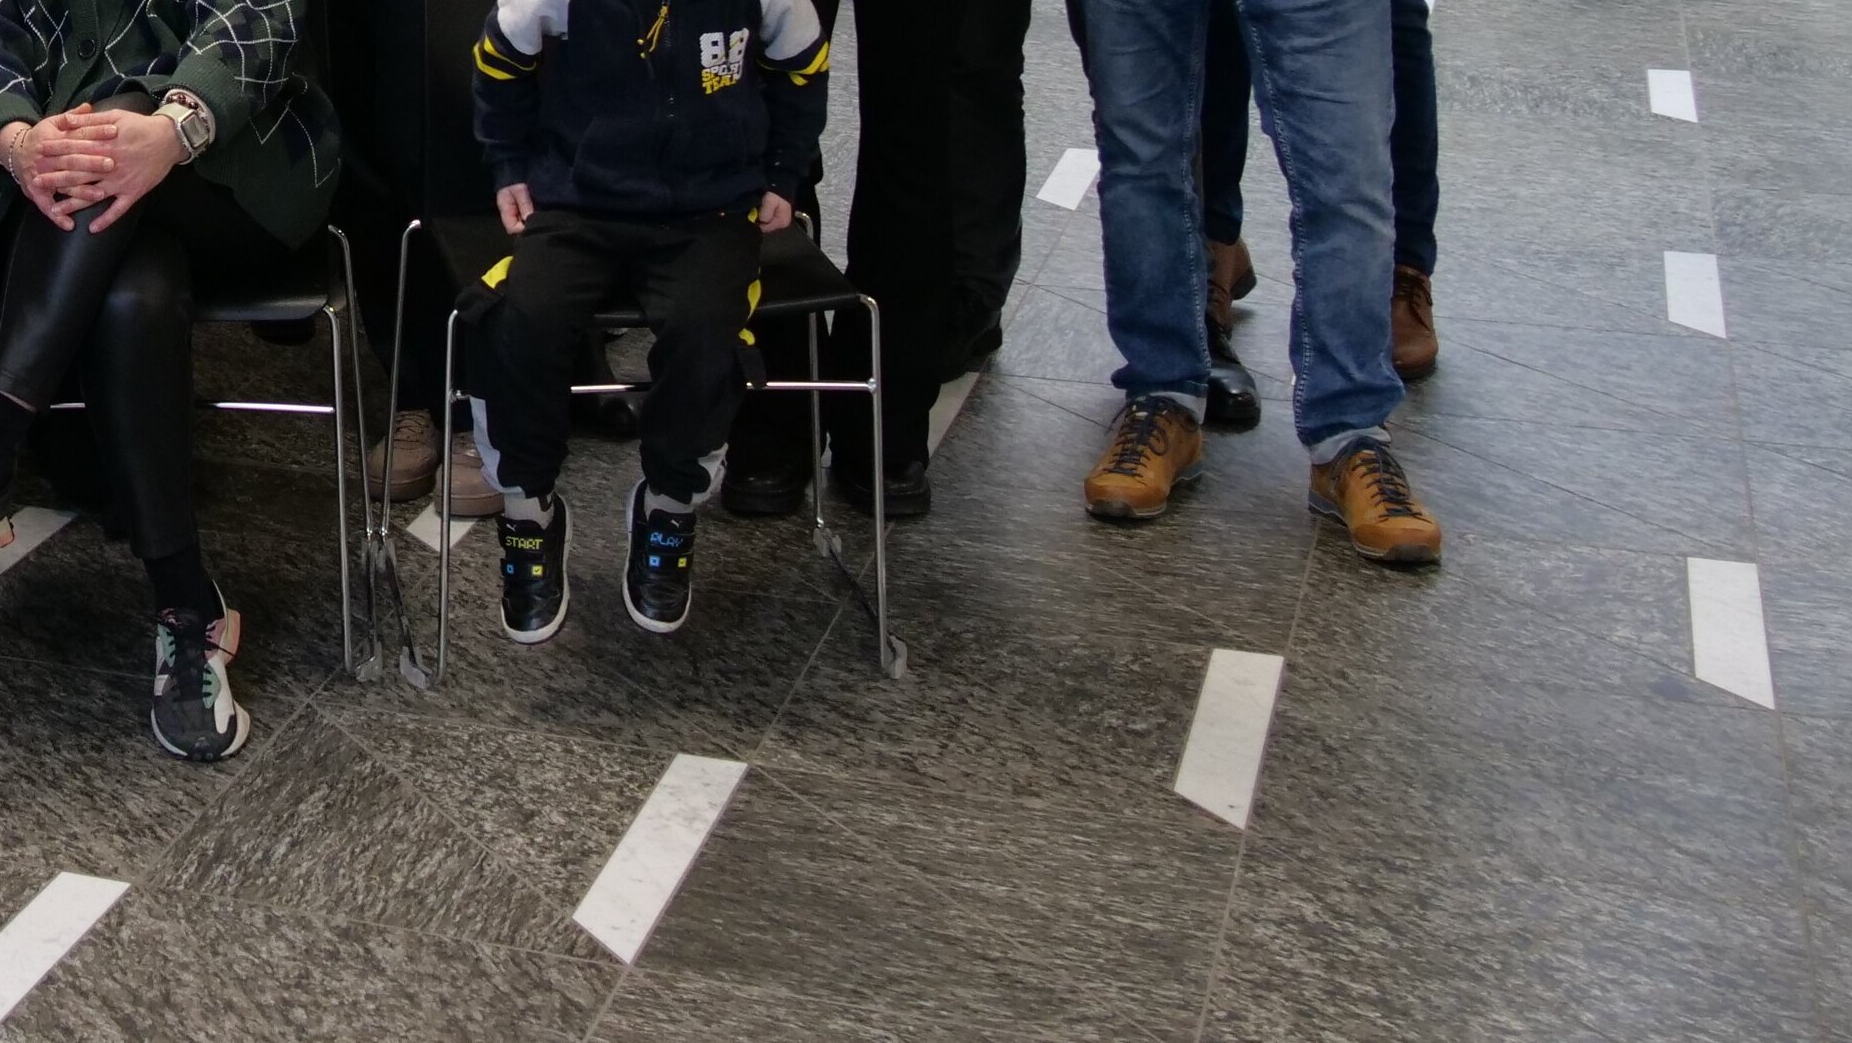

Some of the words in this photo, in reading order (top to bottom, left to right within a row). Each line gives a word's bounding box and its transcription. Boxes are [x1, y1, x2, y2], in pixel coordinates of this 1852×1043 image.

[699, 27, 750, 69] 88
[505, 535, 544, 550] START
[650, 532, 684, 547] PLAY
